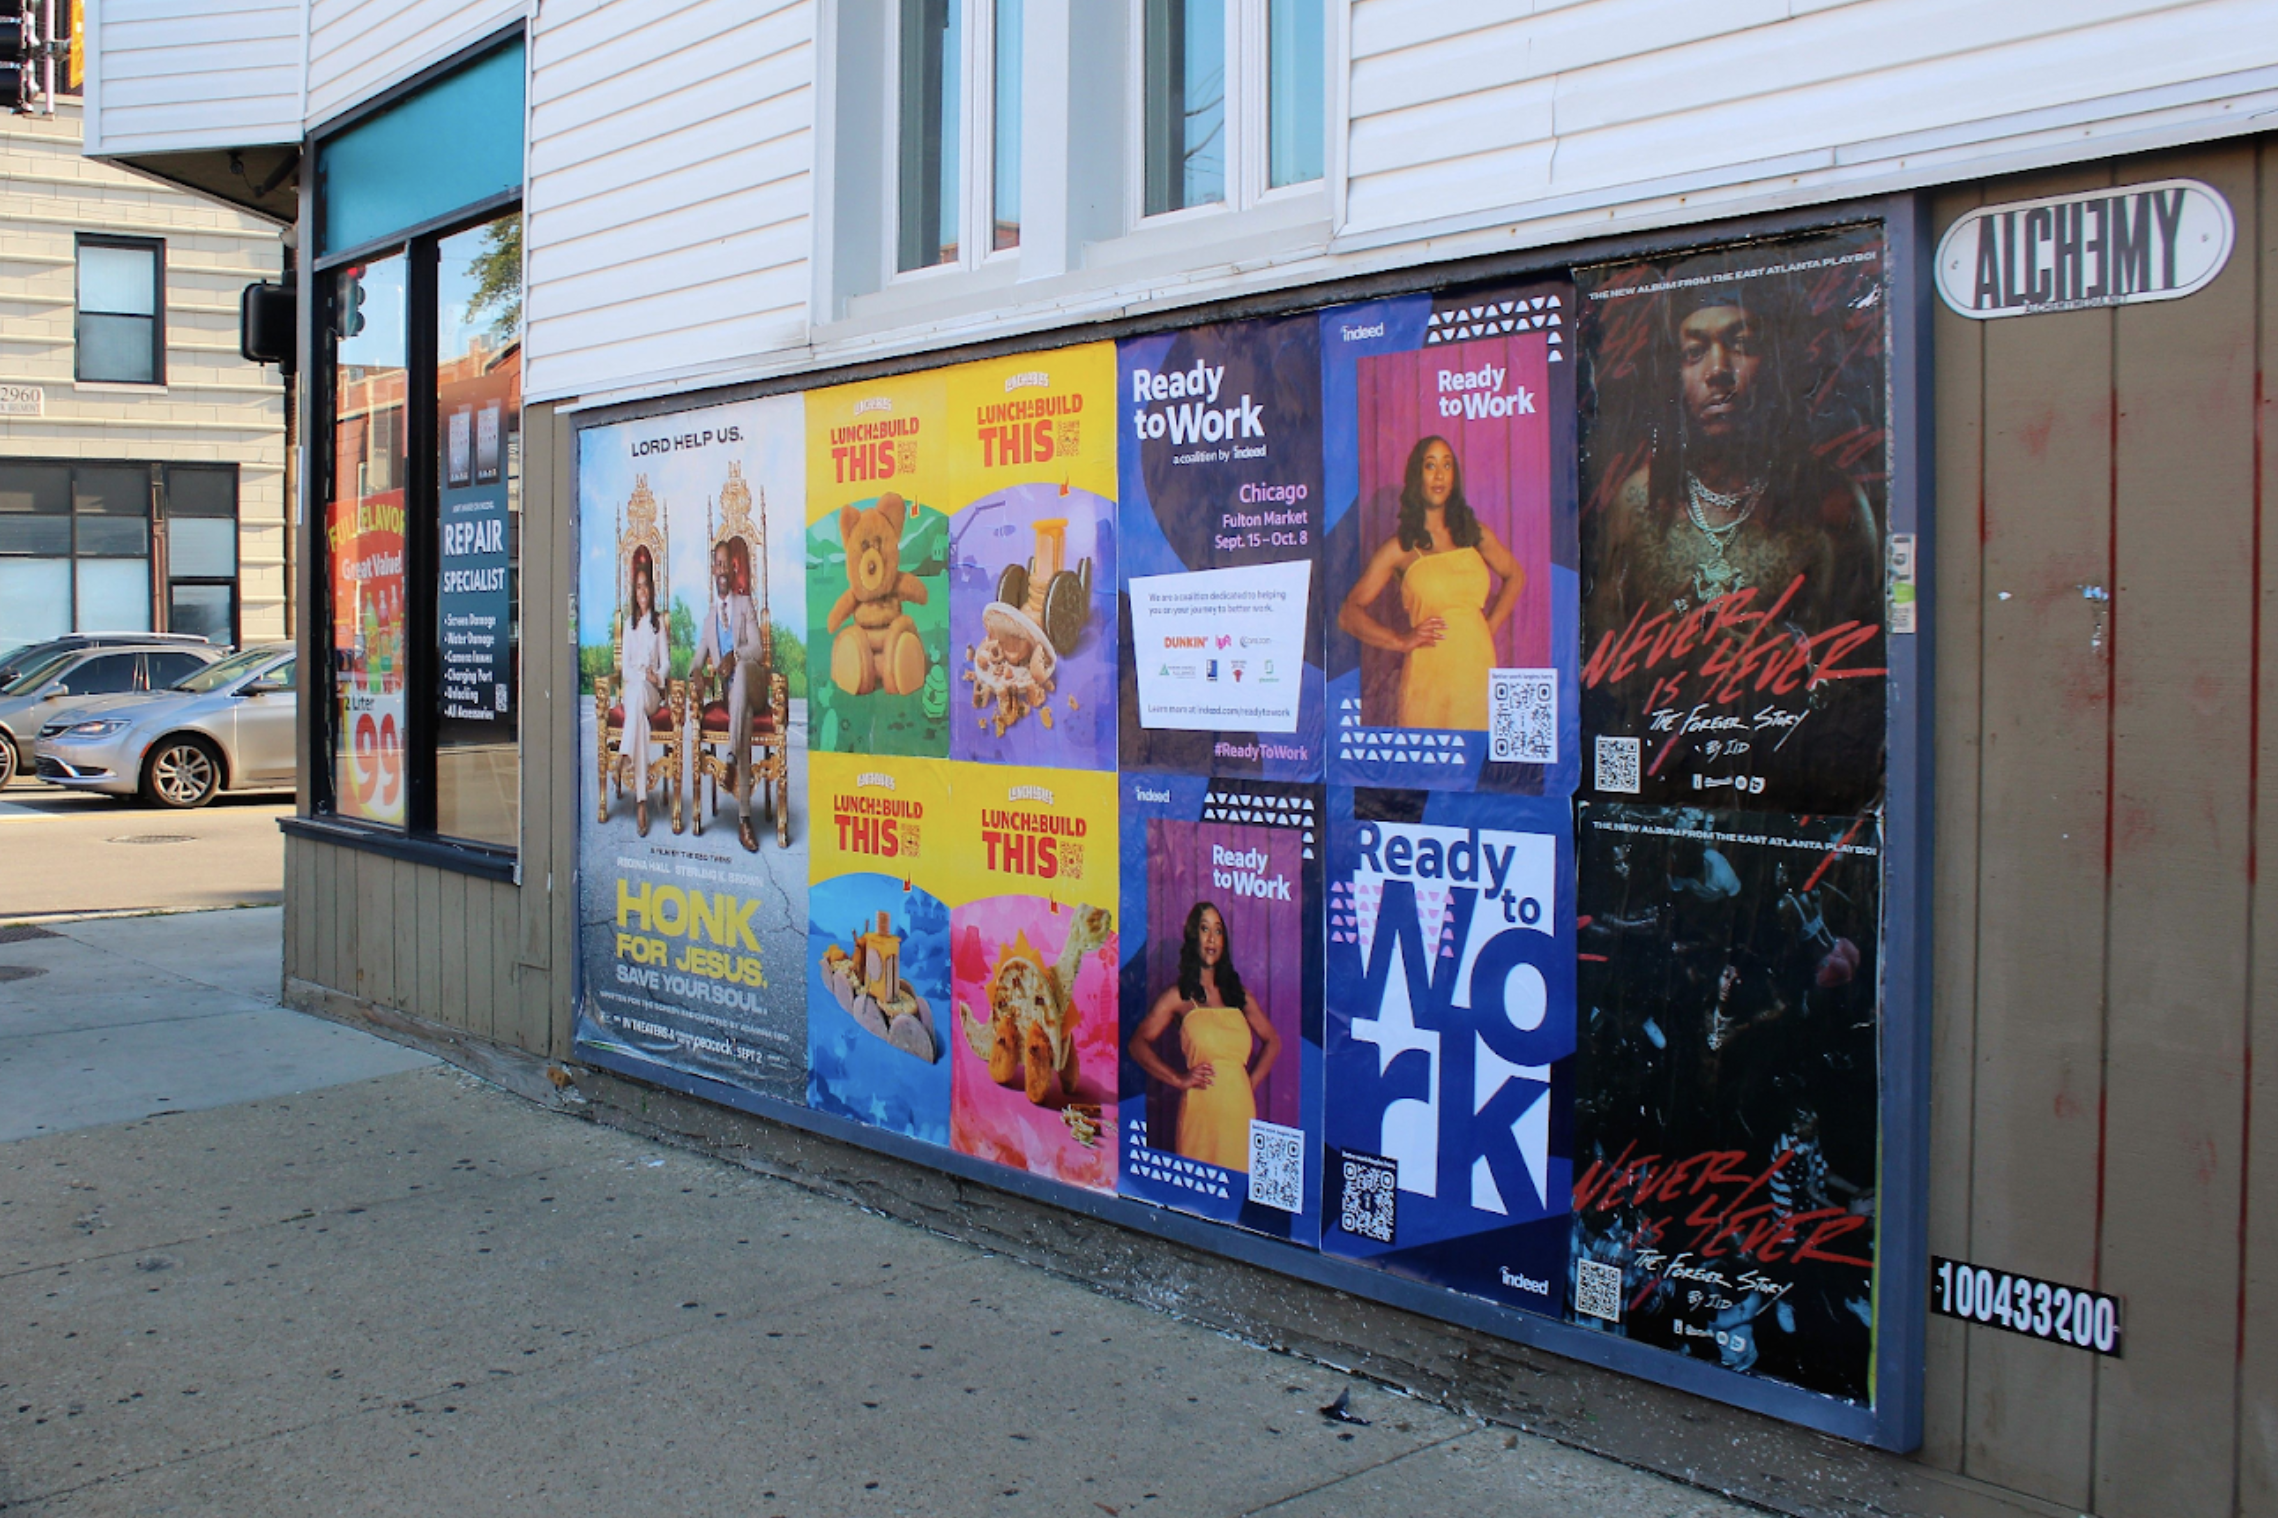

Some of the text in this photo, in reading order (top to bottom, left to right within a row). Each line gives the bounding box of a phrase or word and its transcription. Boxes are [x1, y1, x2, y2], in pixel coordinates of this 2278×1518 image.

[1973, 188, 2186, 310] ALCHEMY
[1588, 251, 1876, 300] THE NEW ALBUM FROM THE EAST ATLANTA PLAYBOI
[1342, 322, 1384, 341] indeed
[1133, 359, 1224, 403] Ready
[1438, 364, 1506, 392] Ready
[1, 387, 40, 402] 2960
[1439, 387, 1535, 420] to Work
[1134, 394, 1265, 445] to Work
[632, 426, 744, 457] LORD HELP US.
[978, 420, 1055, 467] THIS
[1180, 450, 1217, 464] coalition
[1218, 449, 1230, 462] by
[1233, 444, 1267, 459] indeed
[832, 440, 895, 484] THIS
[1240, 482, 1308, 505] Chicago
[1222, 509, 1308, 529] Fulton Market
[444, 519, 503, 556] REPAIR
[1215, 530, 1308, 552] Sept. 15 Oct. 8
[342, 558, 372, 580] Great
[443, 567, 505, 593] SPECIALIST
[1218, 604, 1226, 613] to
[1227, 604, 1251, 613] better
[1257, 589, 1286, 601] helping
[469, 613, 496, 630] Damage
[447, 631, 495, 648] Water Damage
[1164, 637, 1208, 649] DUNKIN'
[447, 668, 493, 685] Charging Port
[344, 694, 375, 711] 2 Liter
[1642, 671, 1687, 714] IS
[1169, 706, 1187, 714] more
[1188, 706, 1196, 714] at
[1650, 703, 1810, 752] THE FOREVER STORY
[356, 713, 400, 806] 99
[1214, 742, 1308, 762] #ReadyToWork
[1136, 786, 1170, 803] indeed
[834, 814, 898, 858] THIS
[1593, 821, 1877, 856] THE NEW ALBUM FROM THE EAST ATLANTA PLAYBOI
[649, 860, 670, 873] HALL
[982, 831, 1057, 879] THIS
[1213, 845, 1268, 875] Ready
[1354, 822, 1516, 898] Ready
[1213, 869, 1291, 901] to Work
[617, 878, 763, 953] HONK
[1501, 888, 1541, 924] to
[617, 933, 768, 989] FOR JESUS.
[616, 964, 768, 1015] SAVE YOUR SOUL.
[693, 1035, 733, 1056] peacock
[737, 1046, 756, 1062] SEPT
[756, 1052, 763, 1065] 2
[1500, 1266, 1549, 1295] indeed
[1634, 1249, 1793, 1316] THE FOREVER STORY
[1938, 1262, 2114, 1351] 100433200
